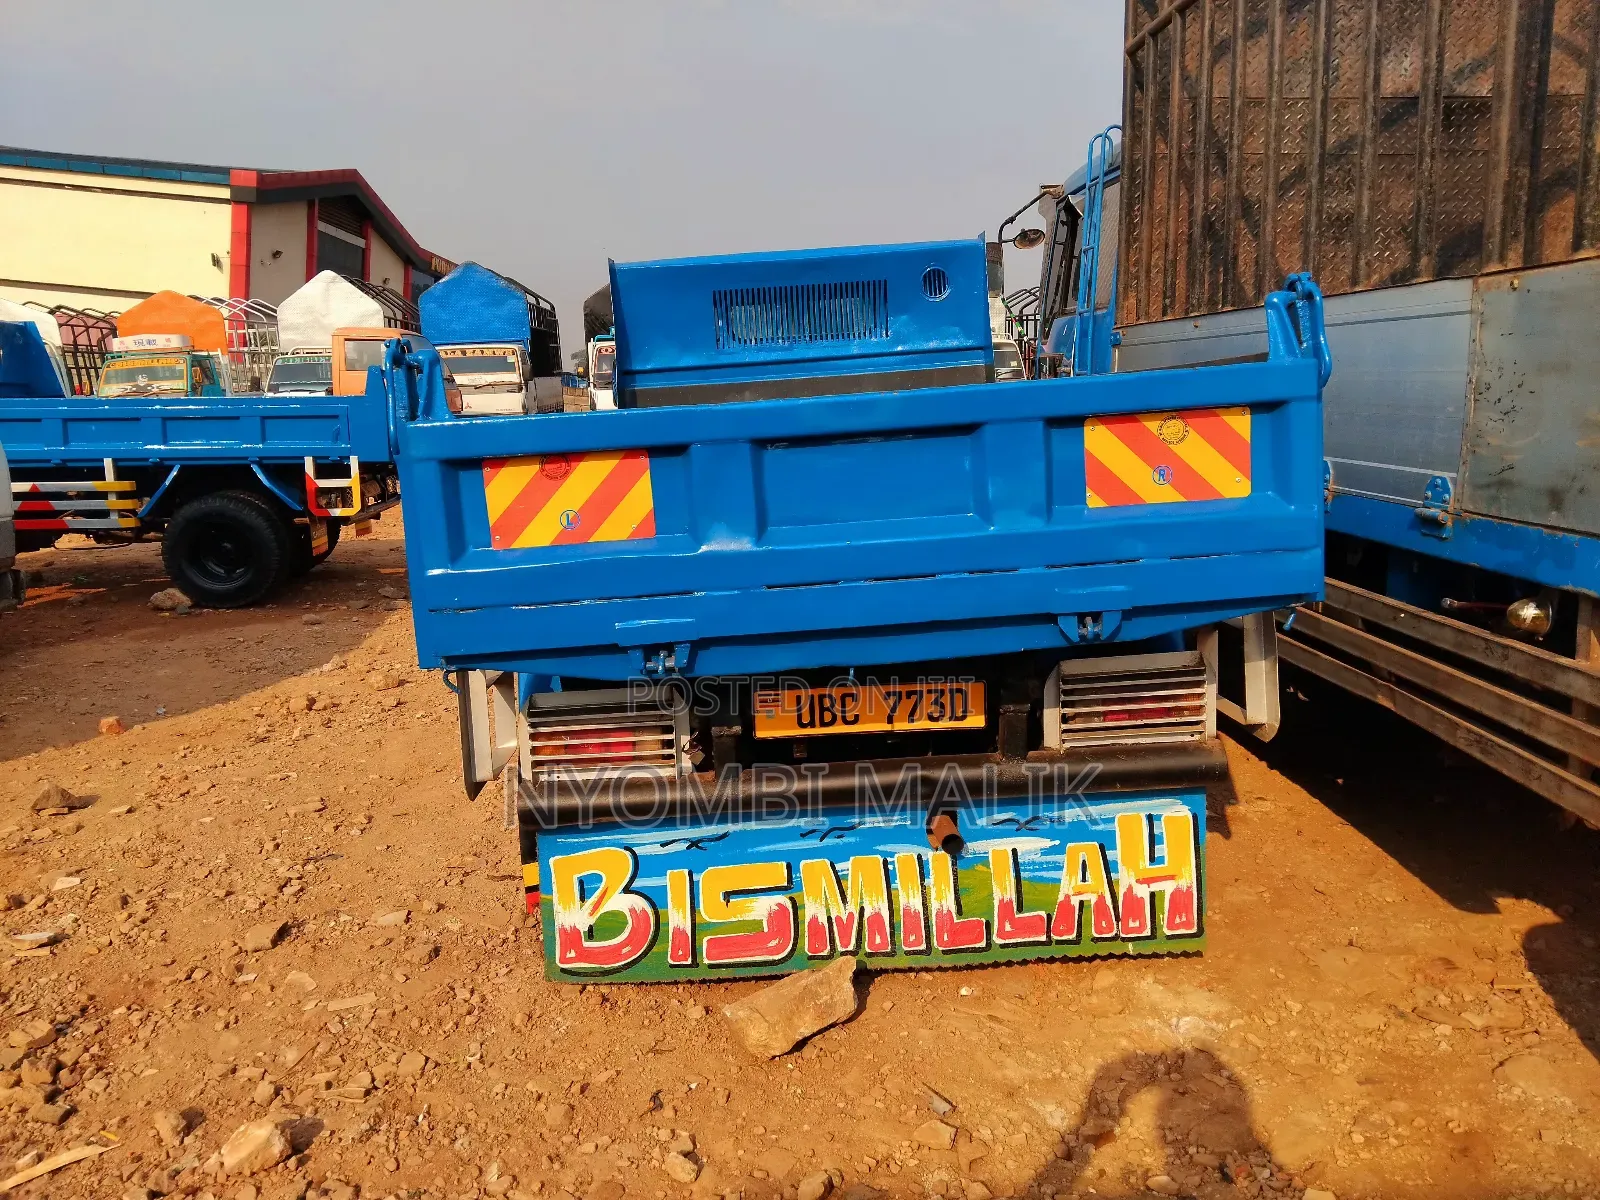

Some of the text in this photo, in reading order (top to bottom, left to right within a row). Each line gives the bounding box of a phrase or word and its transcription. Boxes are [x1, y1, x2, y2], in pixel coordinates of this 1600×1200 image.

[795, 688, 969, 729] UBC 773D
[549, 811, 1203, 975] BISMILLAH
